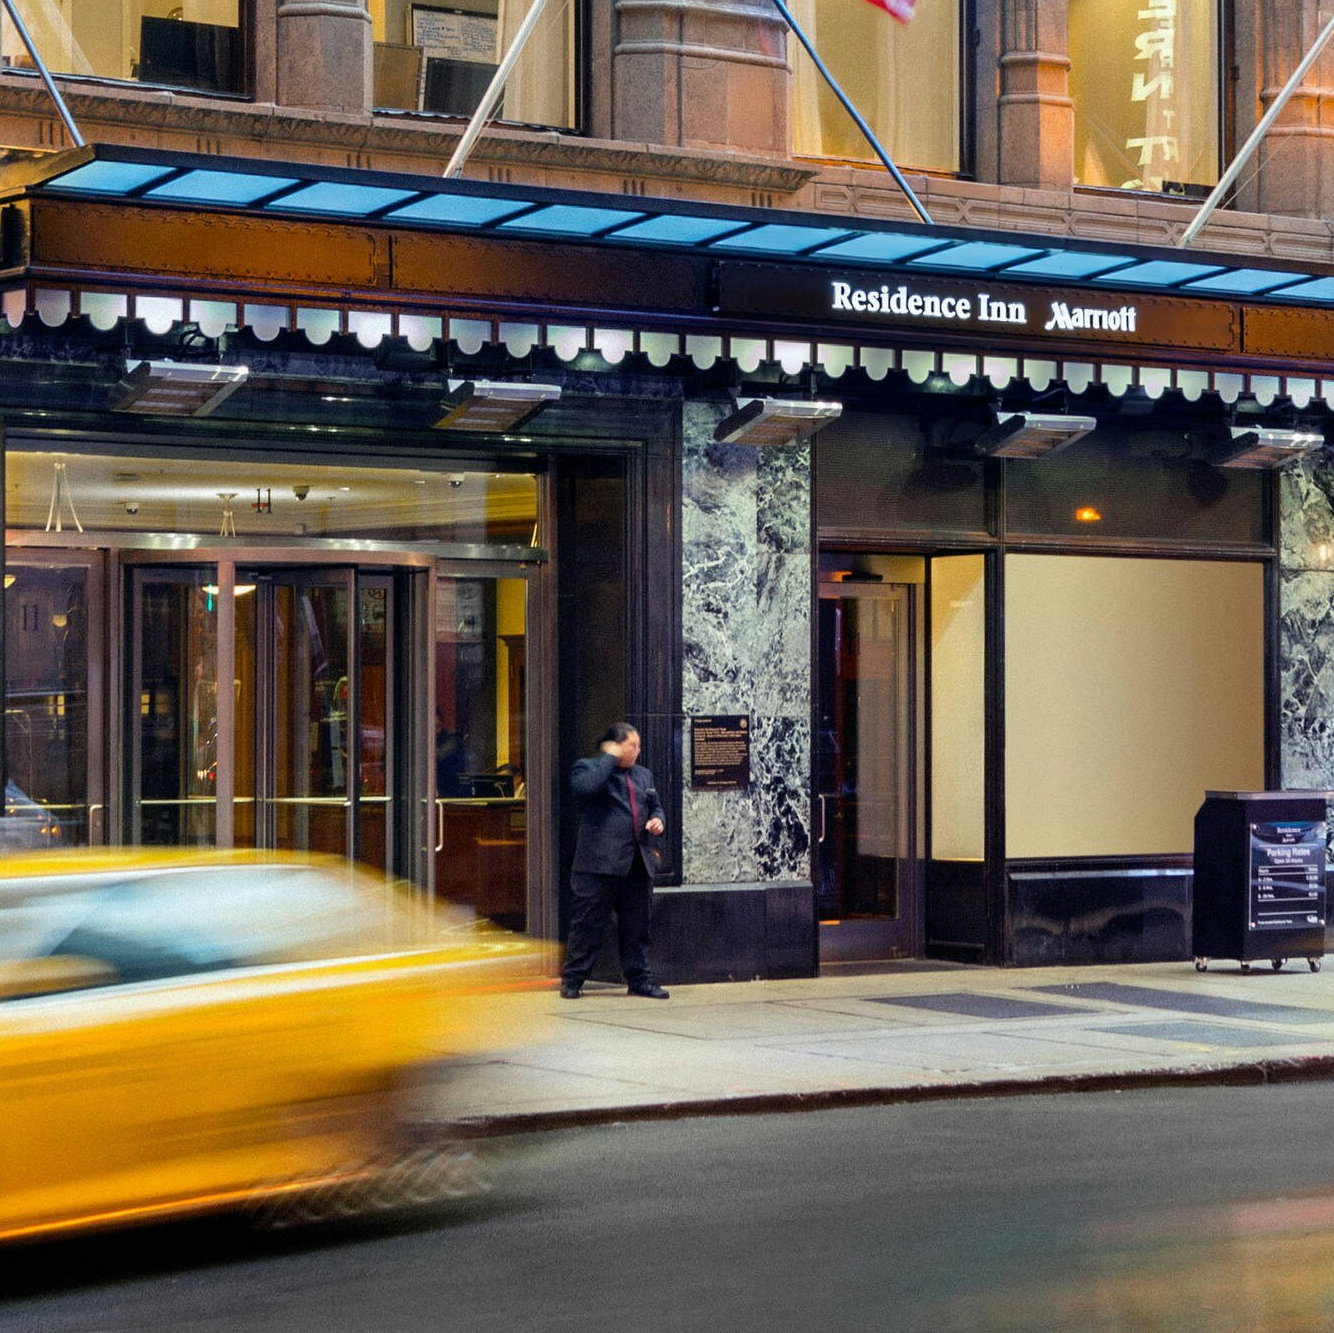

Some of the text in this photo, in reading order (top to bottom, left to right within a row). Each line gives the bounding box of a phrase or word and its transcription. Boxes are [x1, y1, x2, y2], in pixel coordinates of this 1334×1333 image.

[831, 281, 1136, 332] Residence Inn Marriott
[1266, 847, 1311, 858] Parking Rates
